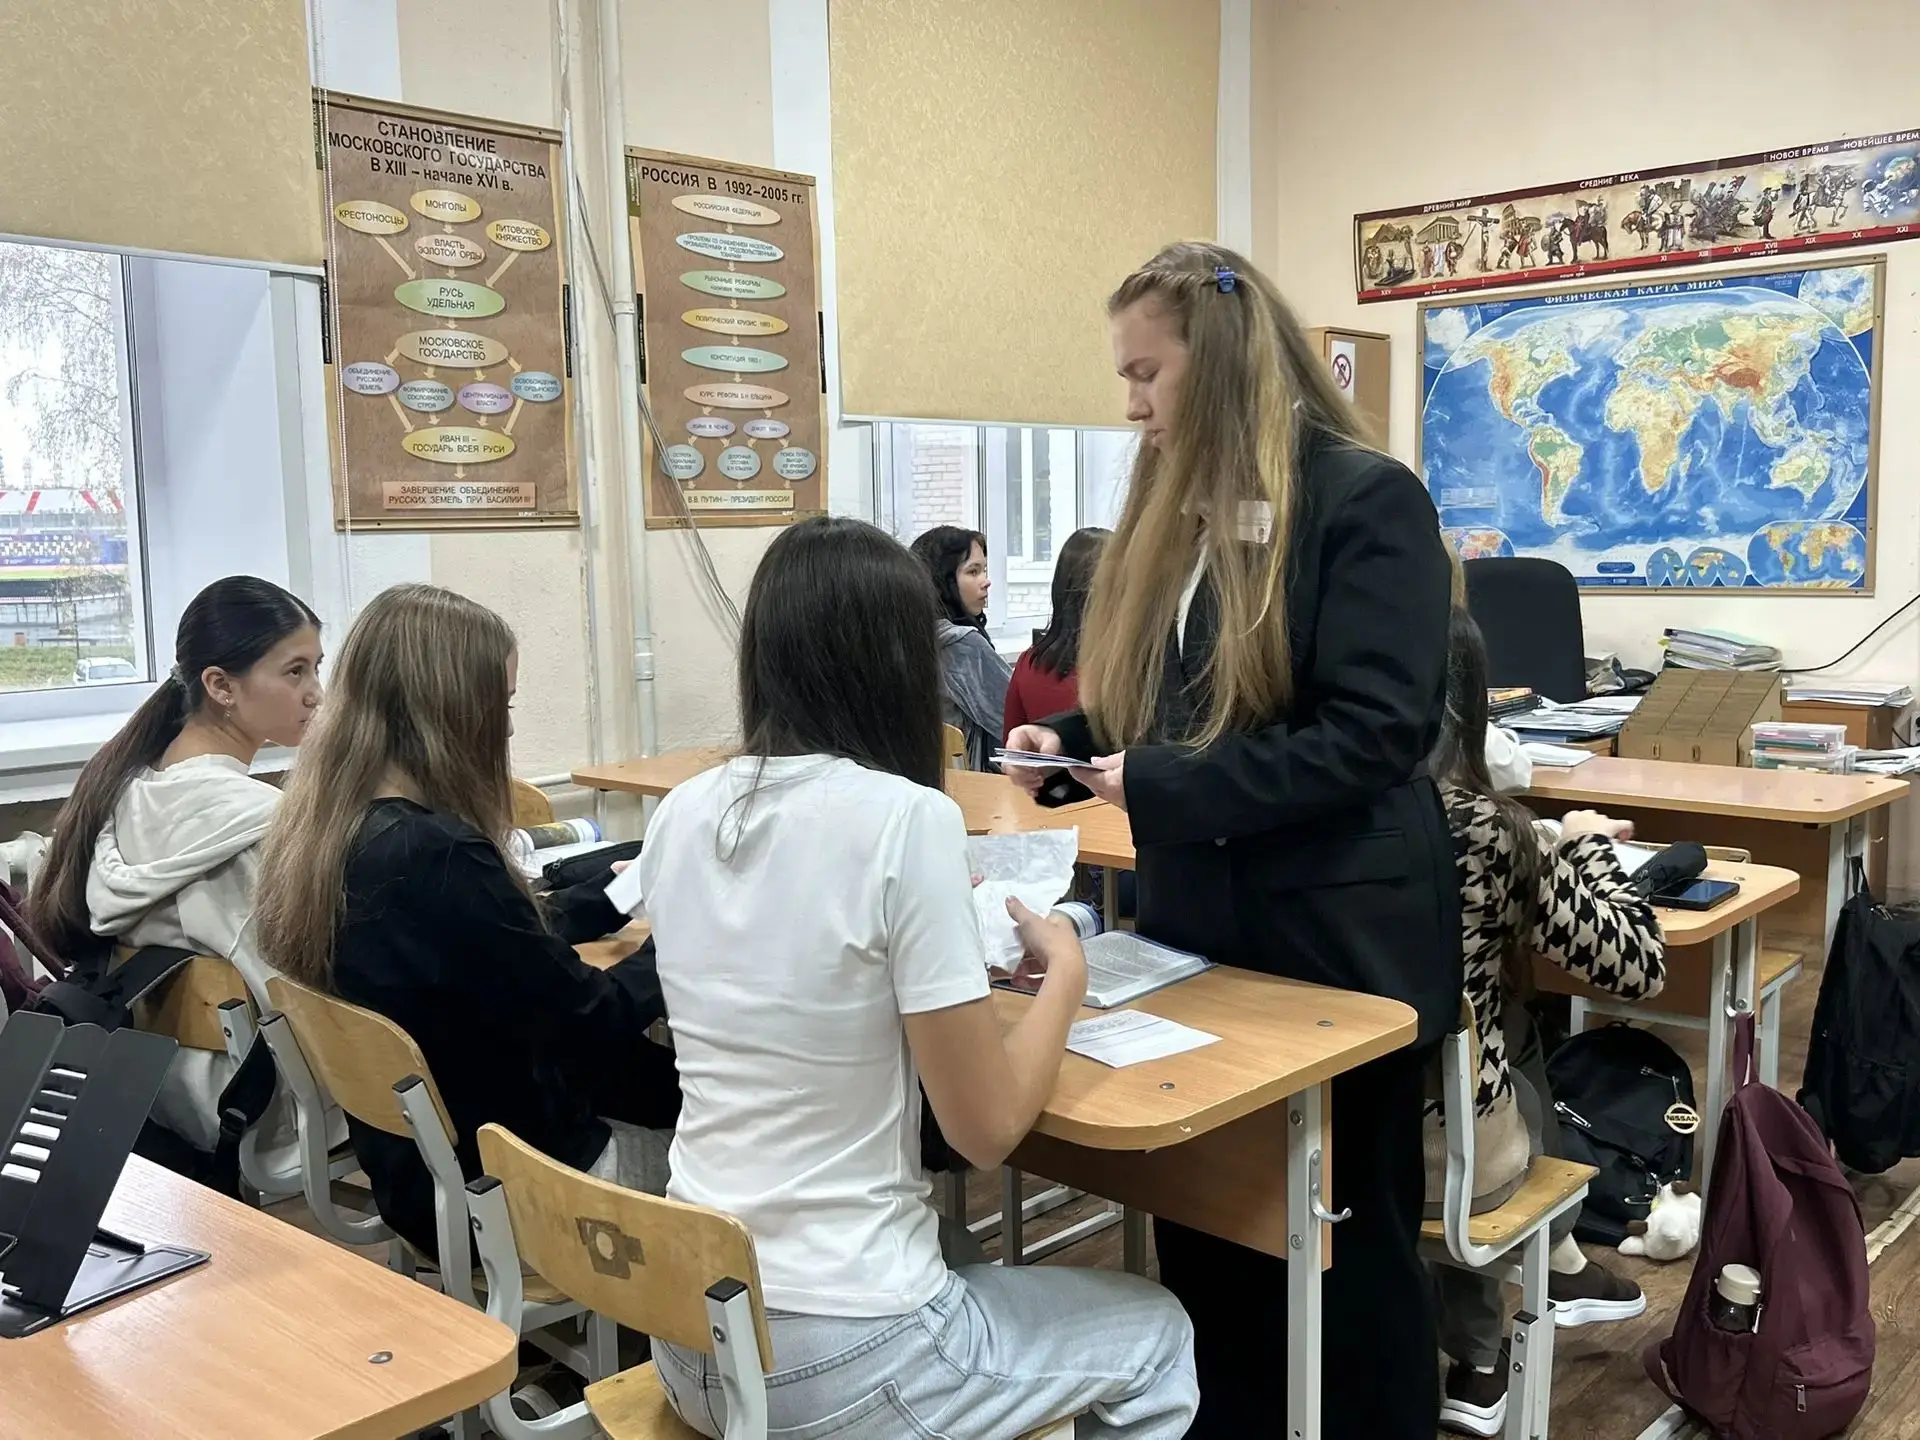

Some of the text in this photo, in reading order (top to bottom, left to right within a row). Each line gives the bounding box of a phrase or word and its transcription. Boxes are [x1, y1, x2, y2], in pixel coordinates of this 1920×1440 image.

[378, 120, 496, 154] СТАНОВЛЕНИЕ
[1843, 135, 1893, 149] НОВЕЙШЕЕ
[329, 132, 546, 178] МОСКОВСКОГО ГОСУДАРСТВА
[1770, 146, 1829, 161] НОВОЕ ВРЕМЯ
[371, 158, 380, 171] В
[386, 160, 406, 176] XIII
[424, 168, 473, 186] начале
[477, 172, 498, 189] XVI
[502, 180, 514, 192] в.
[1580, 173, 1639, 189] СРЕДНИЕ ВЕКА
[642, 166, 804, 204] РОССИЯ В 1992–2005 гг.
[426, 199, 467, 212] МОНГОЛЫ
[1422, 200, 1472, 214] ДРЕВНИЙ МИР
[339, 210, 404, 226] КРЕСТОНОСЦЫ
[496, 223, 541, 236] ЛИТОВСКОЕ
[434, 238, 466, 250] ВЛАСТЬ
[496, 232, 543, 246] КНЯЖЕСТВО
[418, 246, 482, 260] ЗОЛОТОЙ ОРДЫ
[440, 286, 464, 298] РУСЬ
[1544, 279, 1724, 304] ФИЗИЧЕСКАЯ КАРТА МИРА
[427, 298, 475, 310] УДЕЛЬНАЯ
[419, 336, 484, 350] МОСКОВСКОЕ
[419, 348, 486, 360] ГОСУДАРСТВО
[439, 434, 461, 442] ИВАН
[412, 444, 505, 454] ГОСУДАРЬ ВСЕЯ РУСИ
[401, 486, 520, 495] ЗАВЕРШЕНИЕ ОБЪЕДИНЕНИЯ
[388, 496, 426, 504] РУССКИХ
[430, 496, 462, 504] ЗЕМЕЛЬ
[731, 495, 764, 503] ПРЕЗИДЕНТ
